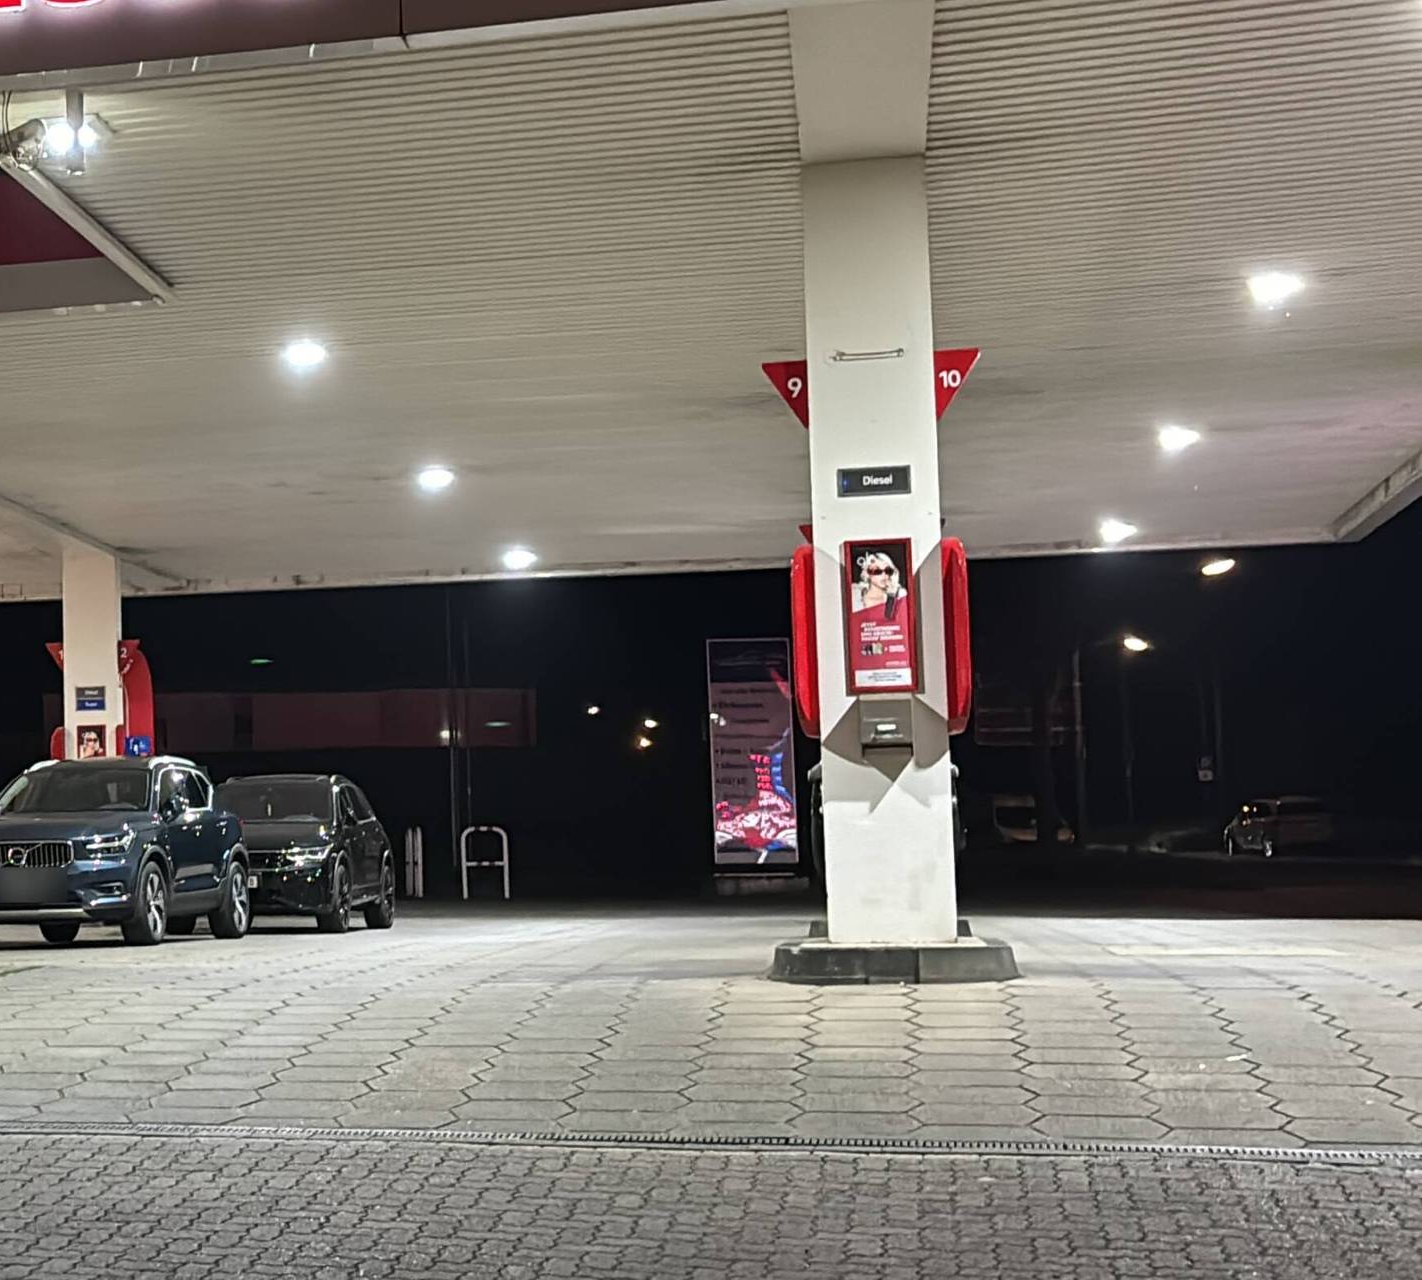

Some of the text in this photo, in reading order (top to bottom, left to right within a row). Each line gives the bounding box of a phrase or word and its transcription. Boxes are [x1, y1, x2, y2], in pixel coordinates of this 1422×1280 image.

[938, 369, 962, 389] 10
[787, 377, 803, 398] 9
[862, 474, 893, 486] Diesel
[120, 647, 128, 658] 2
